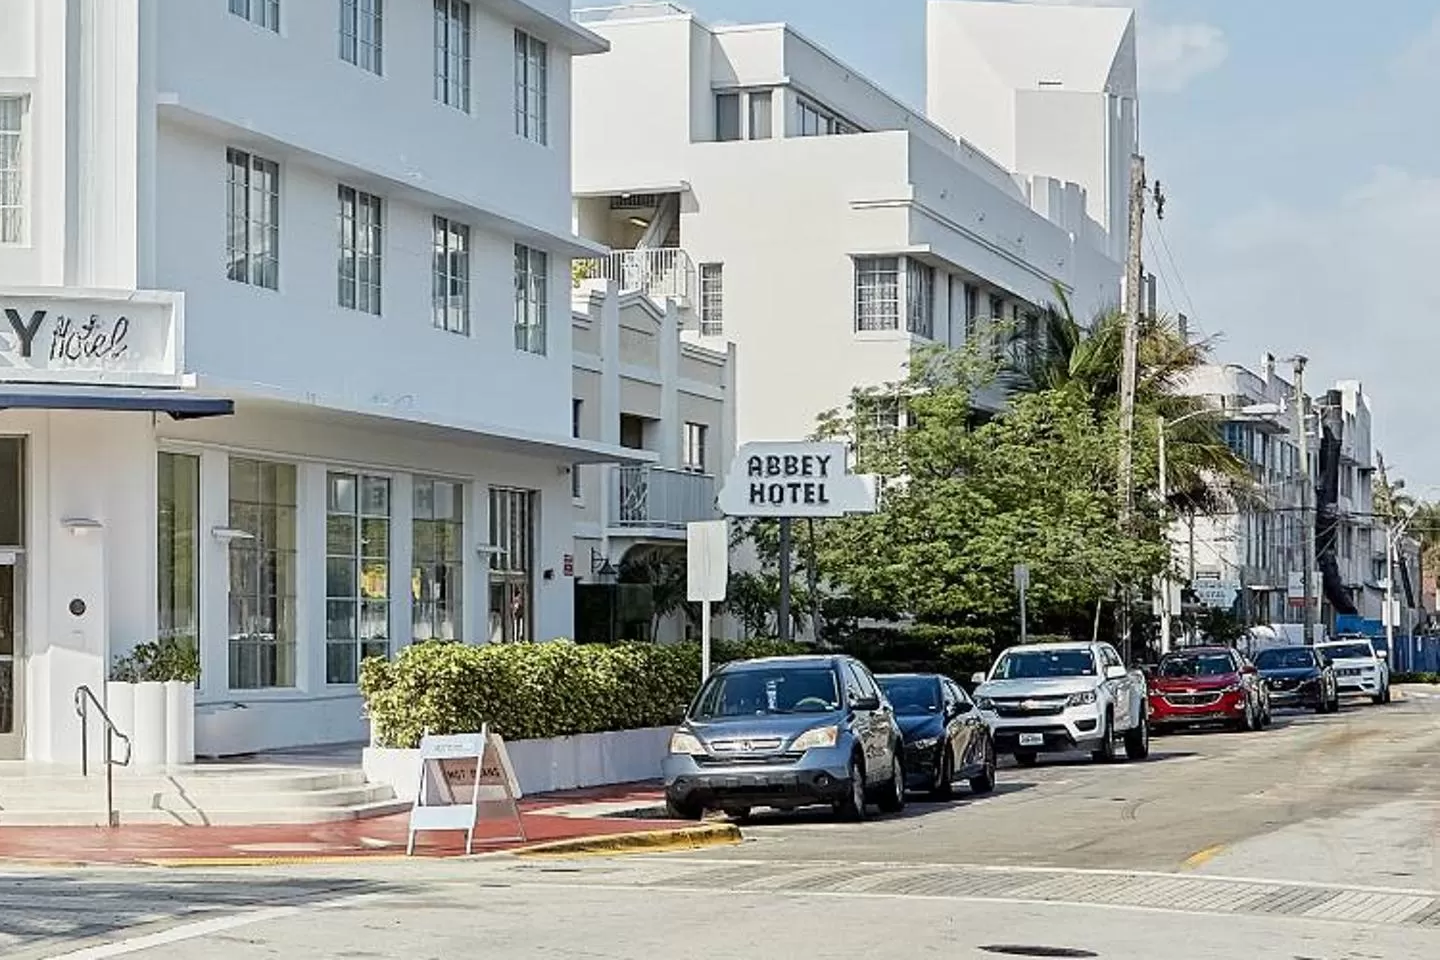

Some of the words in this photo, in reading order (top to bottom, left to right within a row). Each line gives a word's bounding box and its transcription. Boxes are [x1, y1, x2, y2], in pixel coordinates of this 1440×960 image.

[49, 314, 129, 360] Hotel
[747, 454, 832, 477] ABBEY
[749, 482, 830, 504] HOTEL
